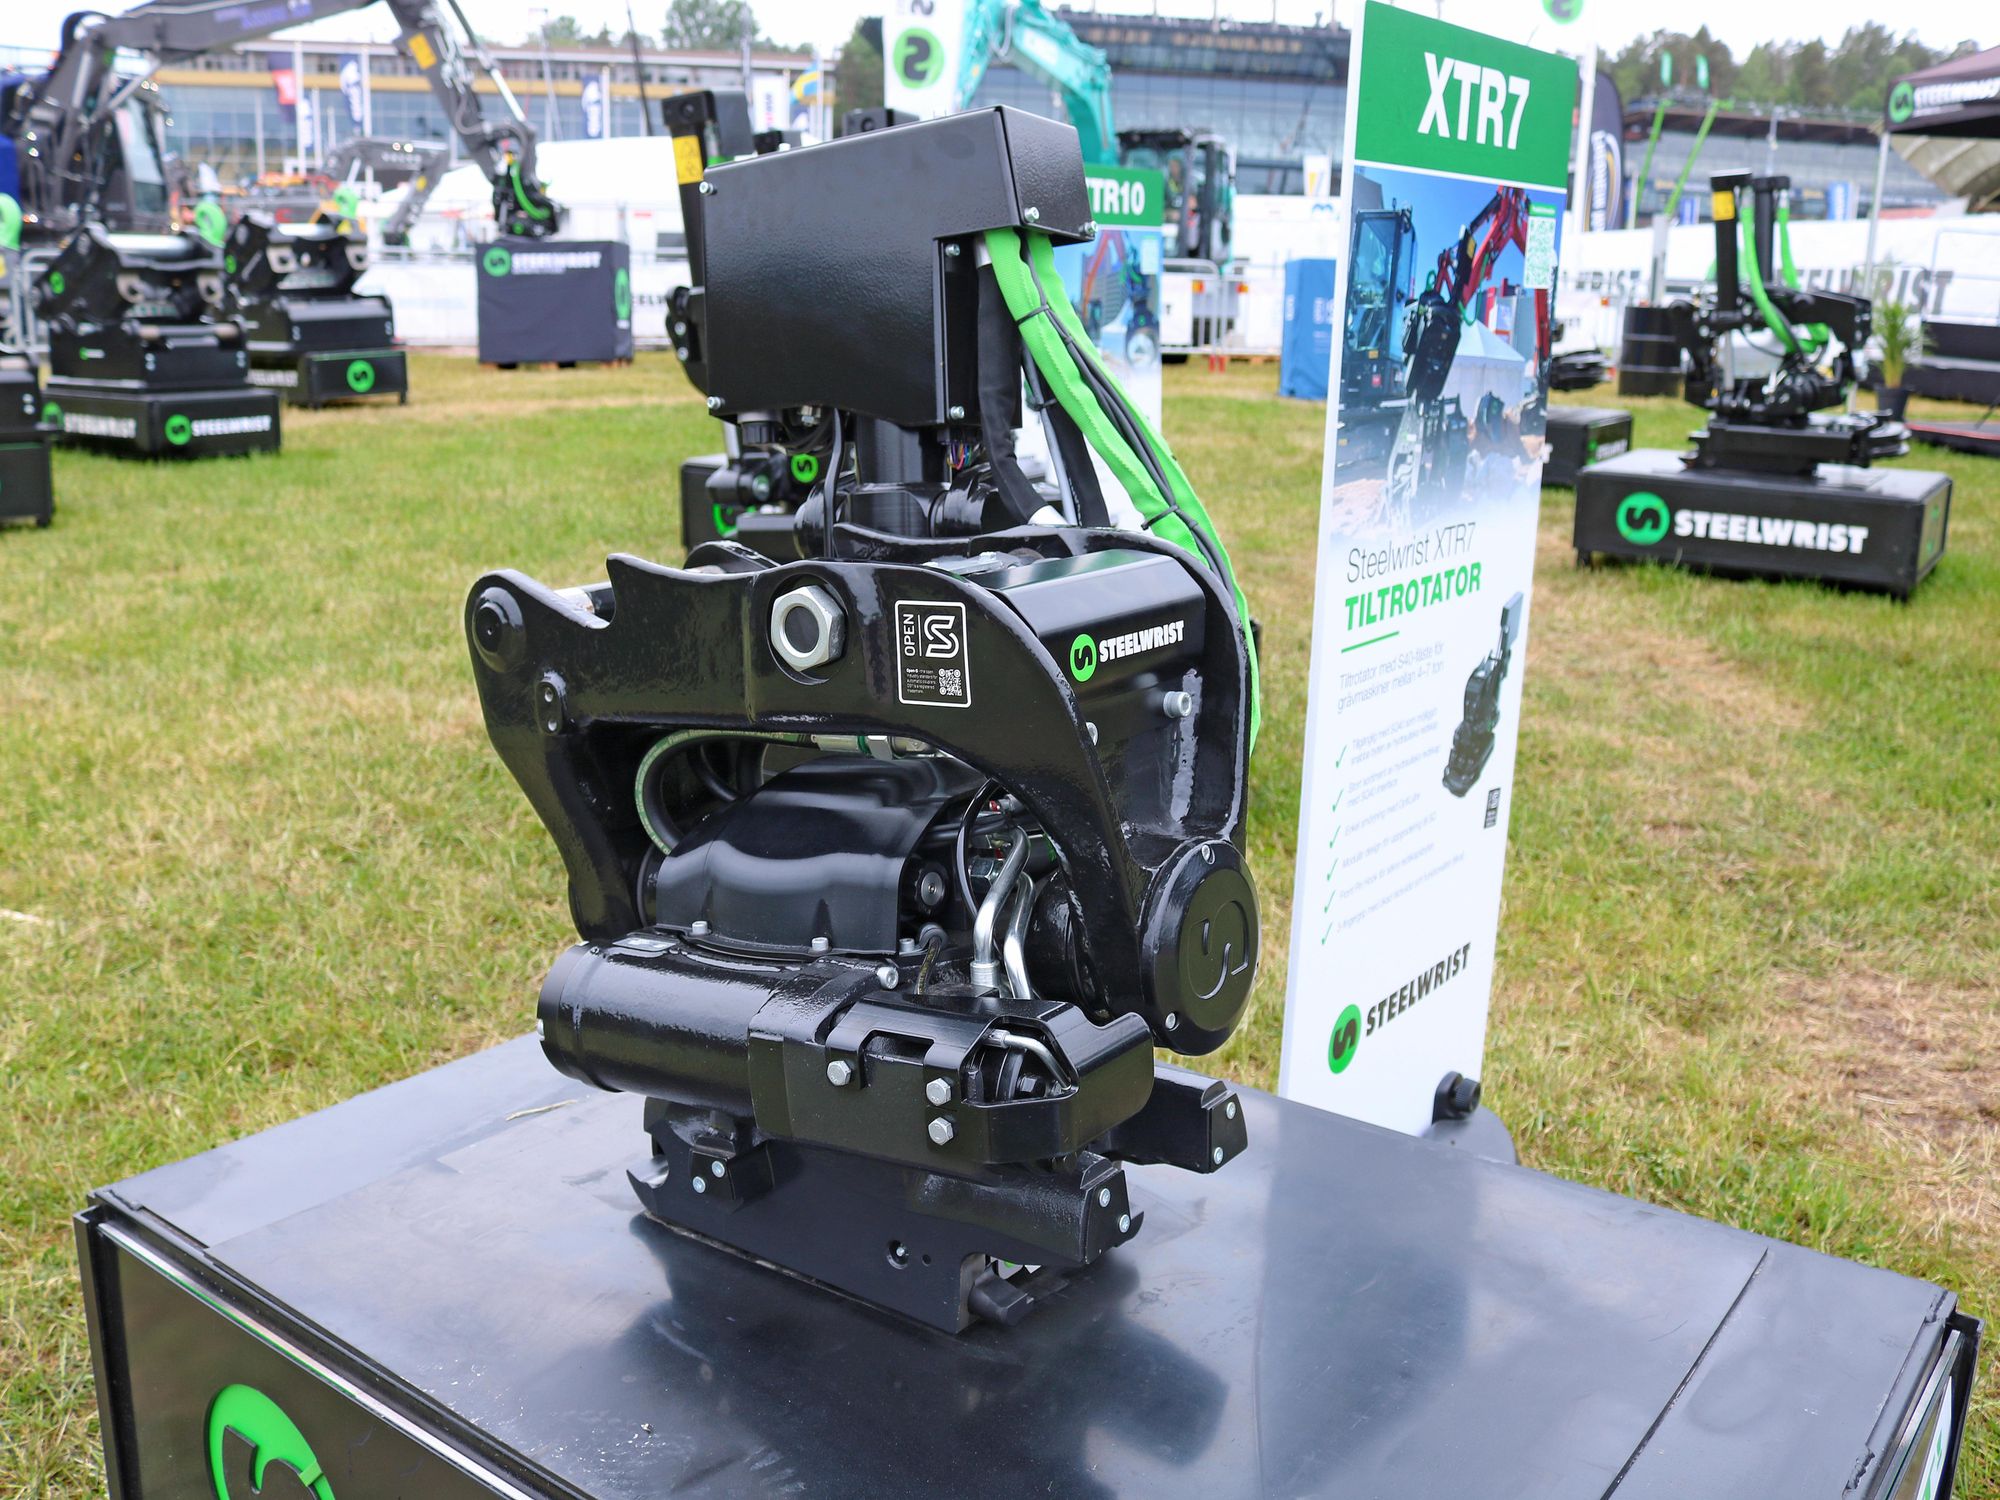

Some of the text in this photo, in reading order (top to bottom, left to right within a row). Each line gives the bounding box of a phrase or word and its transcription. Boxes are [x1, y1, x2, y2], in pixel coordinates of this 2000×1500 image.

[1416, 51, 1531, 150] XTR7
[191, 414, 272, 437] STEELWRIST
[1346, 521, 1477, 584] Steelwrist XTR7
[1673, 509, 1869, 554] STEELWRIST
[1345, 562, 1482, 631] TILTROTATOR
[903, 613, 916, 657] OPEN
[1098, 619, 1185, 663] STEELWRIST
[1339, 666, 1378, 691] Tiltrotator
[1378, 657, 1397, 675] med
[1366, 942, 1471, 1038] STEELWRIST
